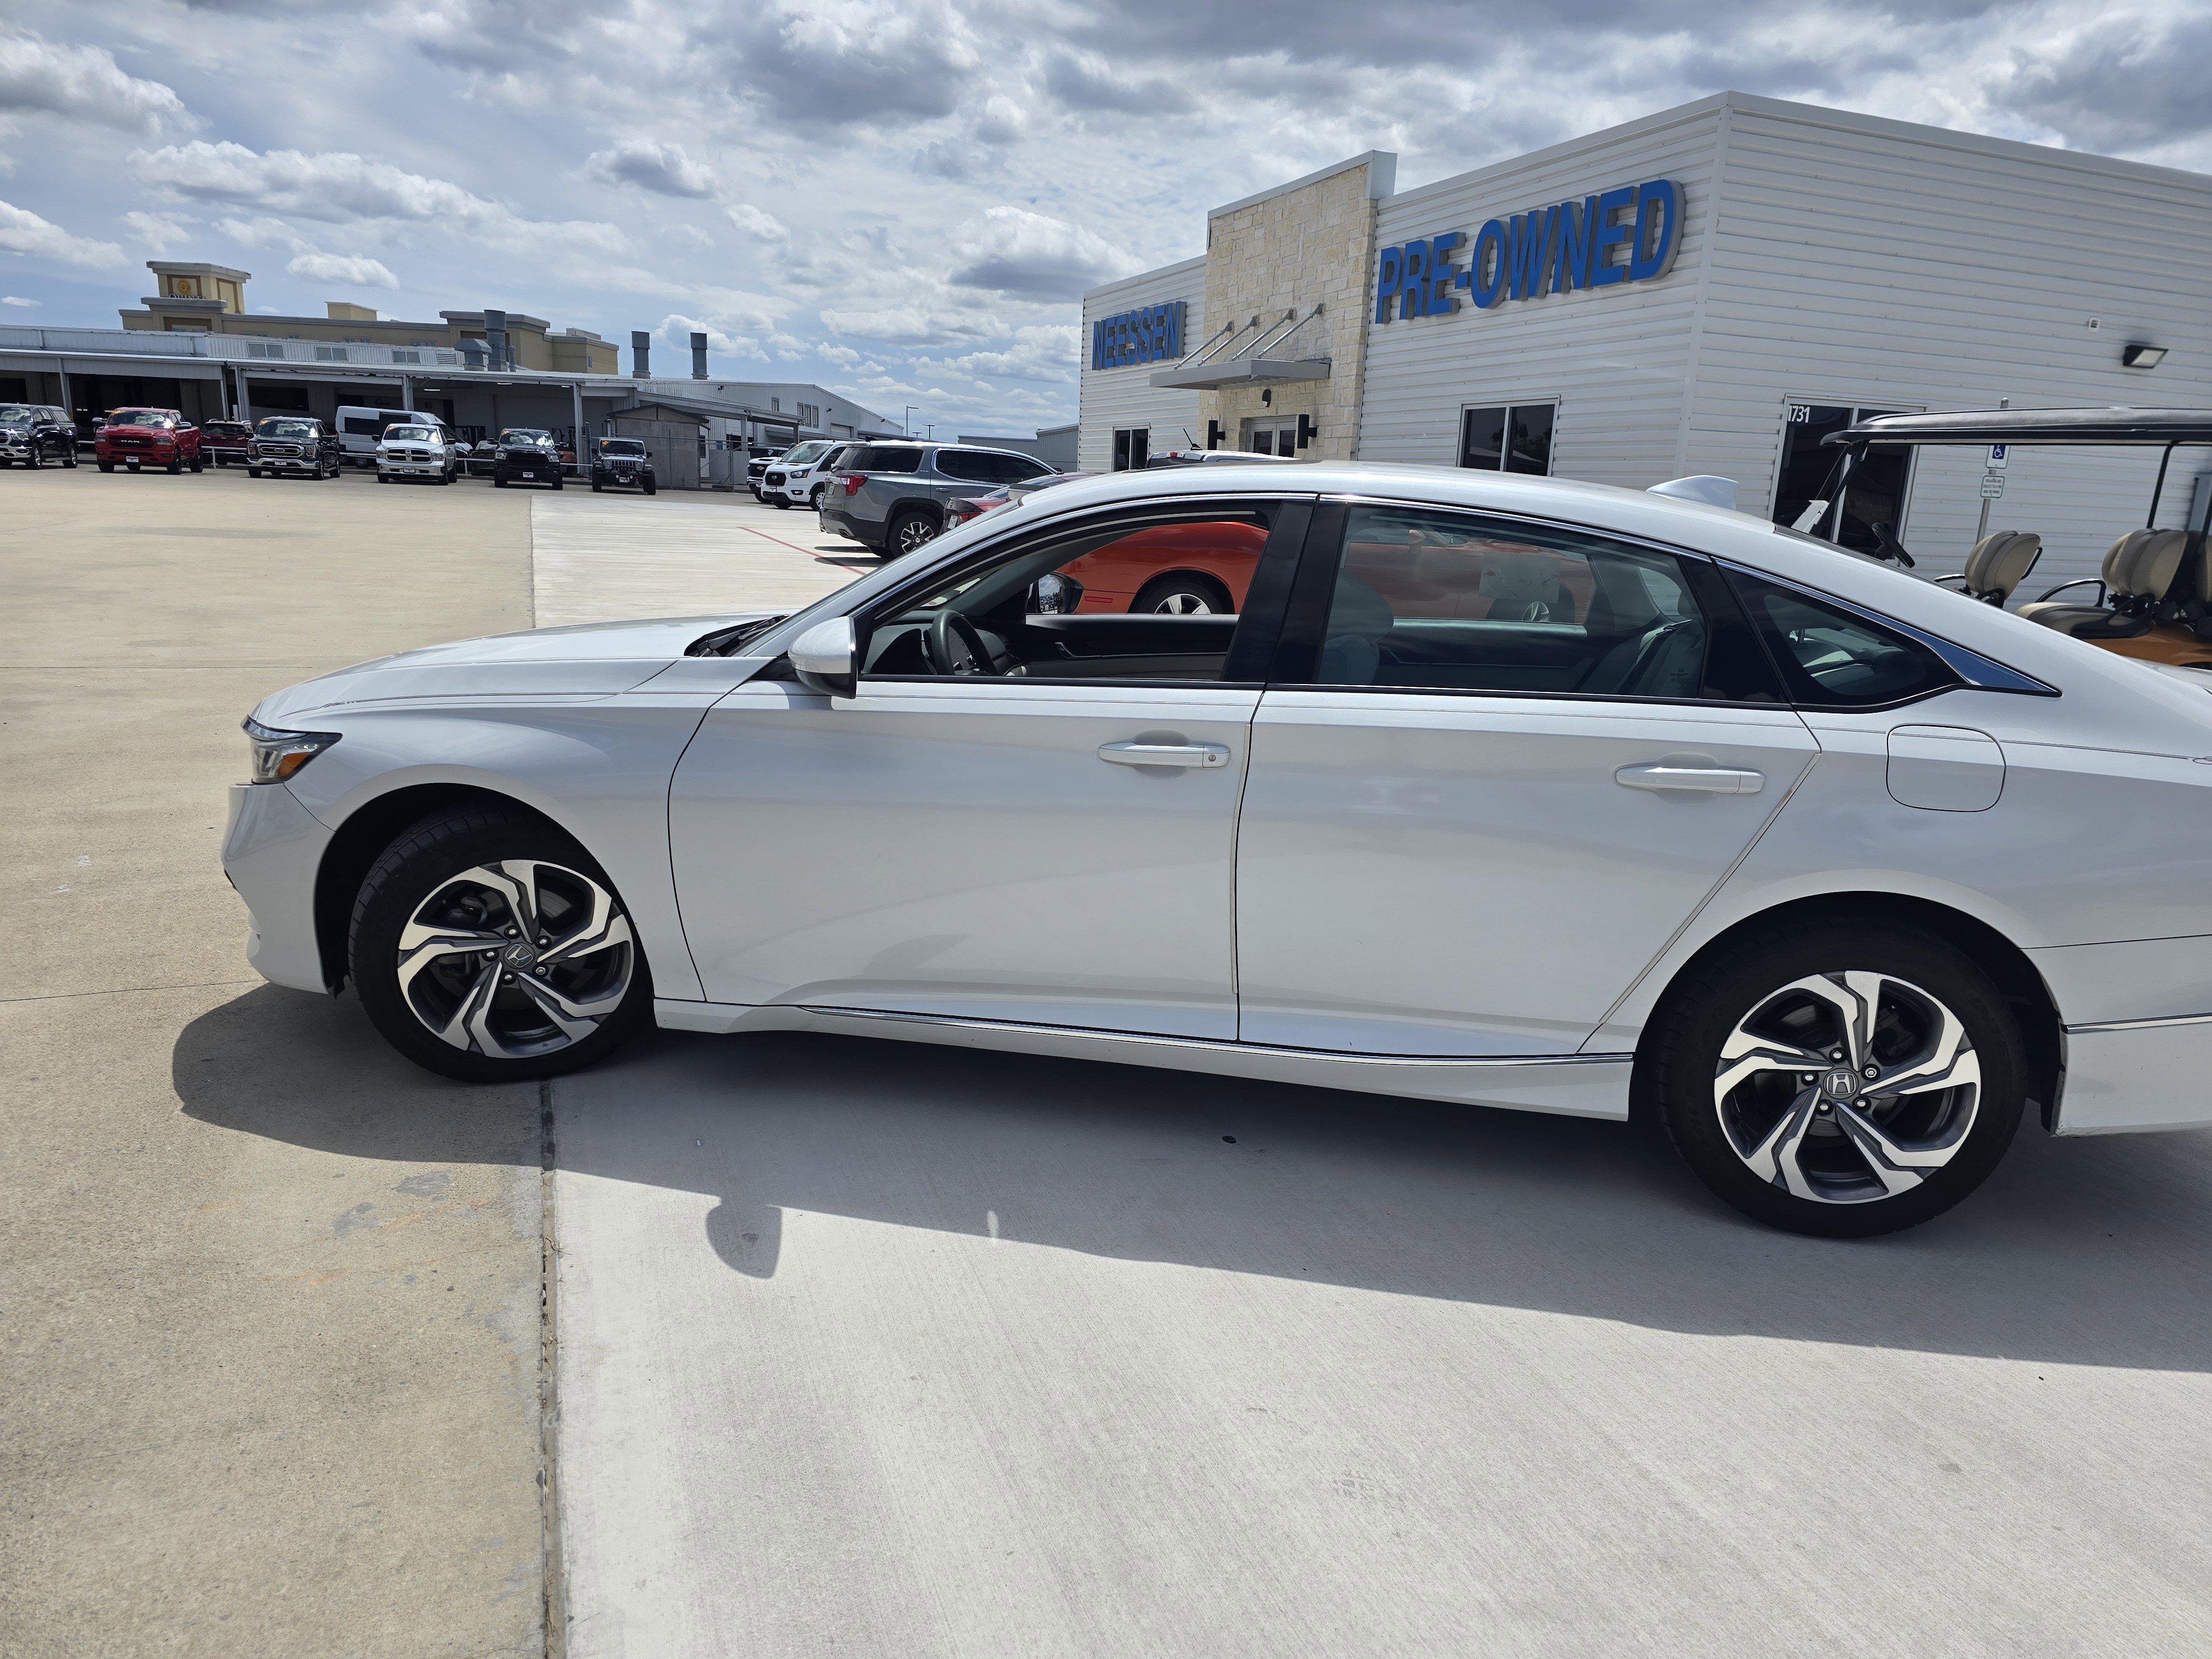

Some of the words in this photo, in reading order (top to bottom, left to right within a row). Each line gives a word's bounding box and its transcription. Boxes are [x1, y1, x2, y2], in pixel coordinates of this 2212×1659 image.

[1375, 179, 1686, 324] PRE-OWNED
[1092, 301, 1187, 371] NEESSEN
[1787, 405, 1810, 423] 1731
